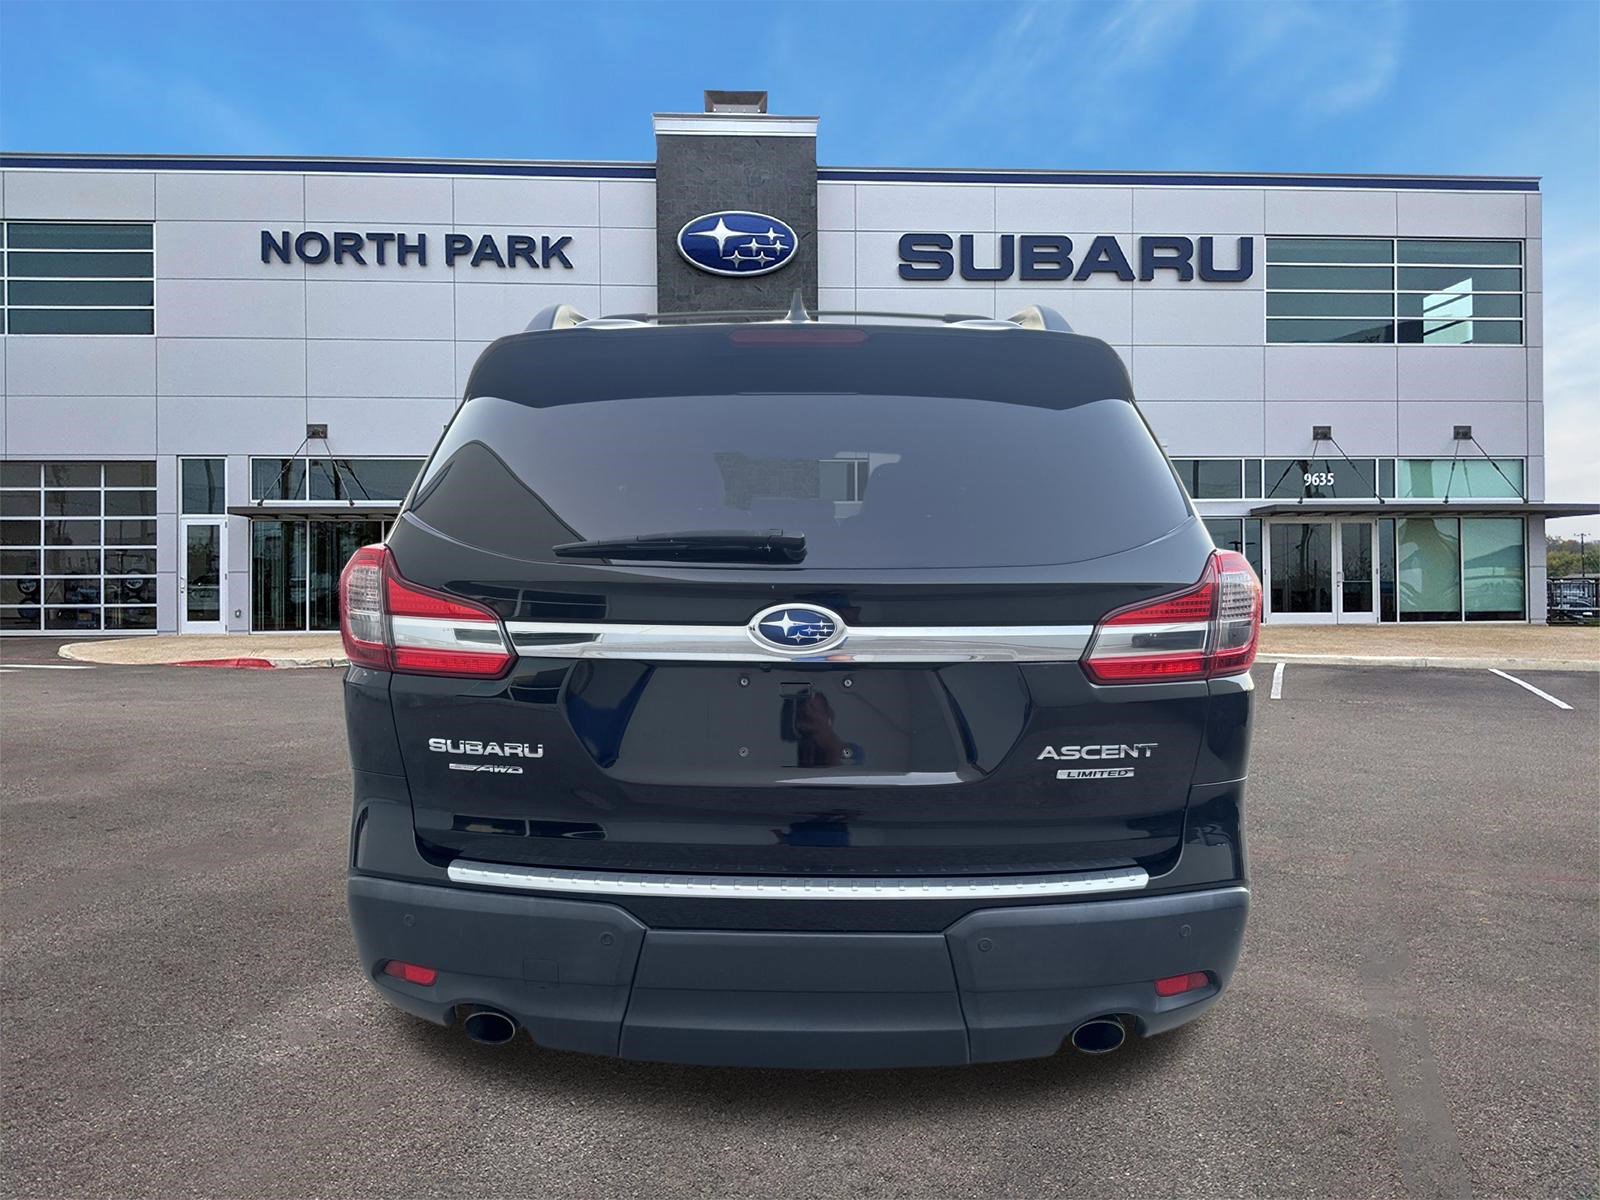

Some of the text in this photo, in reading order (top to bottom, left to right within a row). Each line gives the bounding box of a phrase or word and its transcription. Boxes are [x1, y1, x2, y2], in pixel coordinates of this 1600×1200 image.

[261, 230, 574, 269] NORTH PARK
[898, 233, 1254, 282] SUBARU
[1303, 473, 1335, 486] 9635
[428, 738, 544, 758] SUBARU
[1036, 743, 1159, 760] ASCENT
[476, 764, 523, 774] AWD
[1066, 769, 1129, 778] LIMITED
